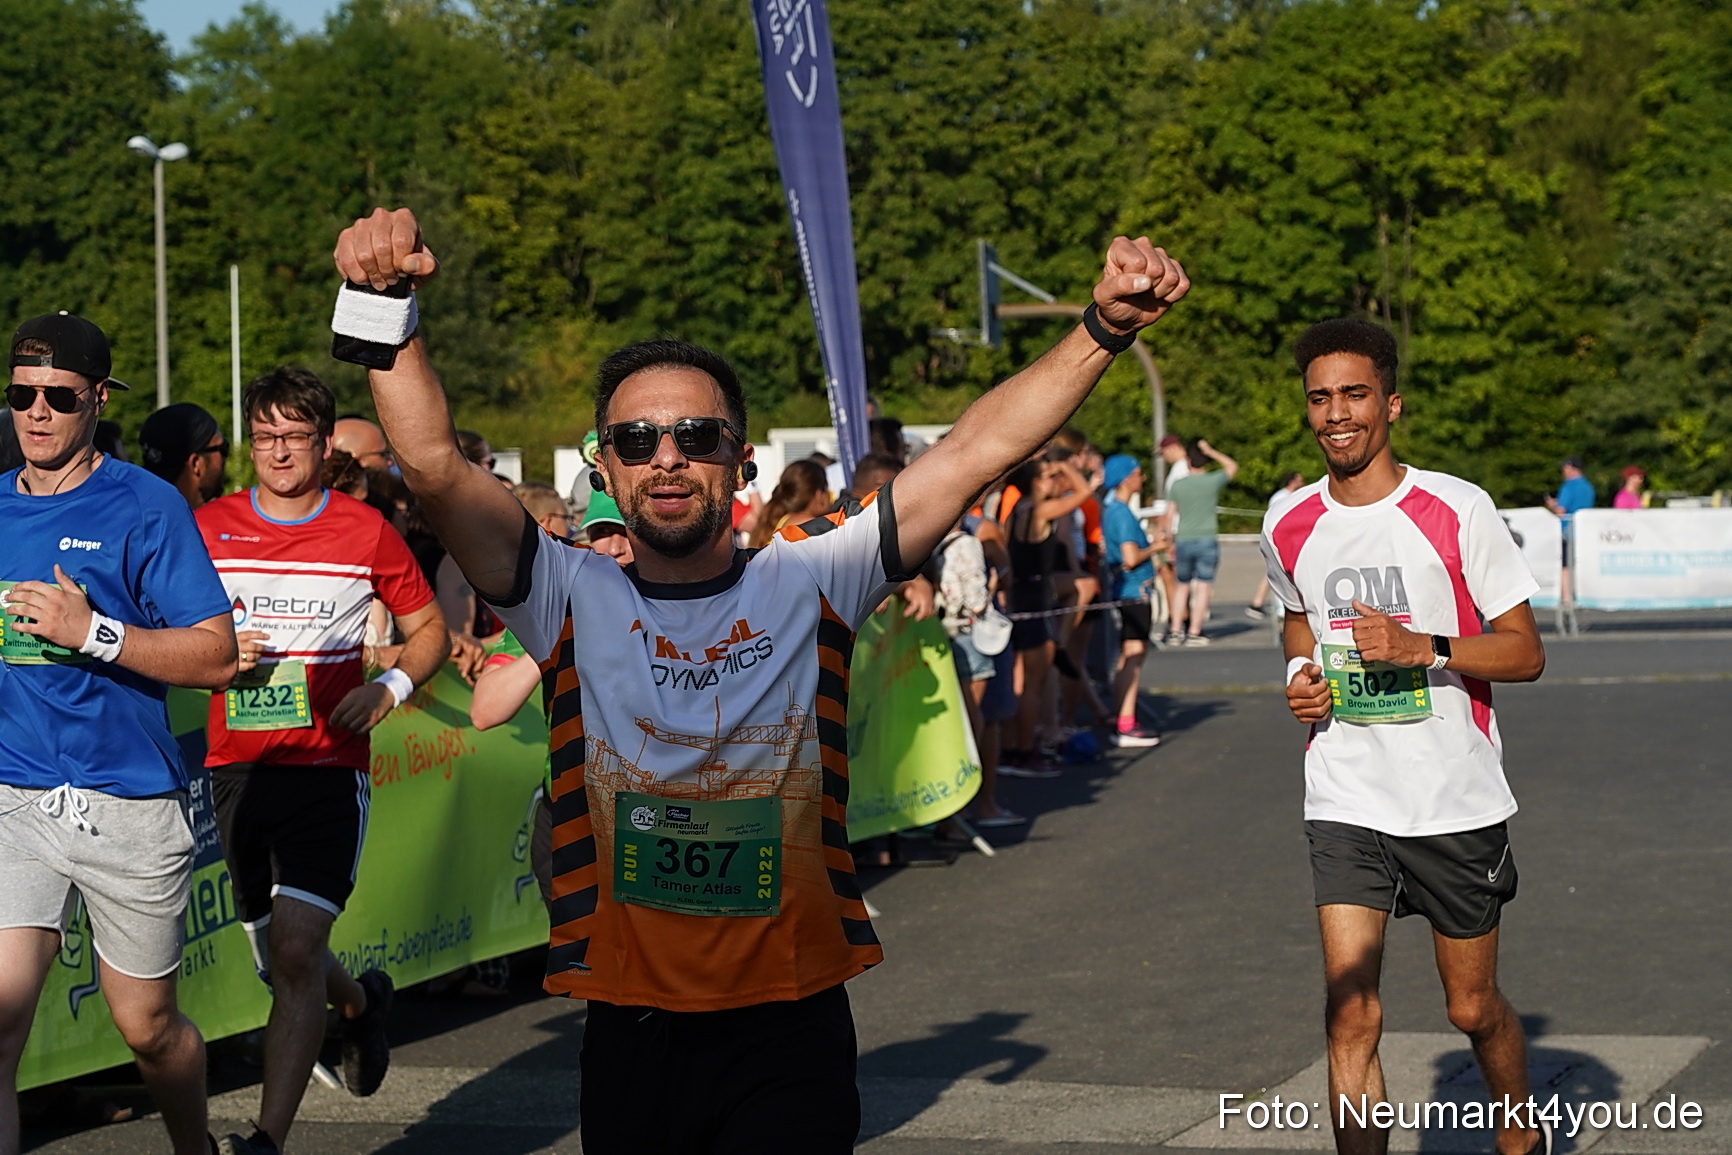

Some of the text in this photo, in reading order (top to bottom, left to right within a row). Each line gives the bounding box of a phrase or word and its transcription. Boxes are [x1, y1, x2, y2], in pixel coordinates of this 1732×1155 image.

[71, 538, 102, 551] Berger
[1324, 566, 1408, 610] OM
[252, 596, 337, 619] Petry
[237, 684, 294, 709] 1232
[1330, 679, 1343, 706] RUN
[1348, 671, 1401, 697] 502
[1411, 670, 1426, 707] 2022
[228, 692, 237, 717] RUN
[260, 708, 298, 718] Christian
[295, 685, 307, 717] 2022
[1347, 697, 1408, 709] Brown David
[658, 819, 710, 831] Firmenlauf
[624, 843, 638, 882] RUN
[655, 838, 740, 878] 367
[651, 875, 742, 895] Tamer Atlas
[757, 846, 773, 899] 2022
[179, 938, 216, 981] arkt
